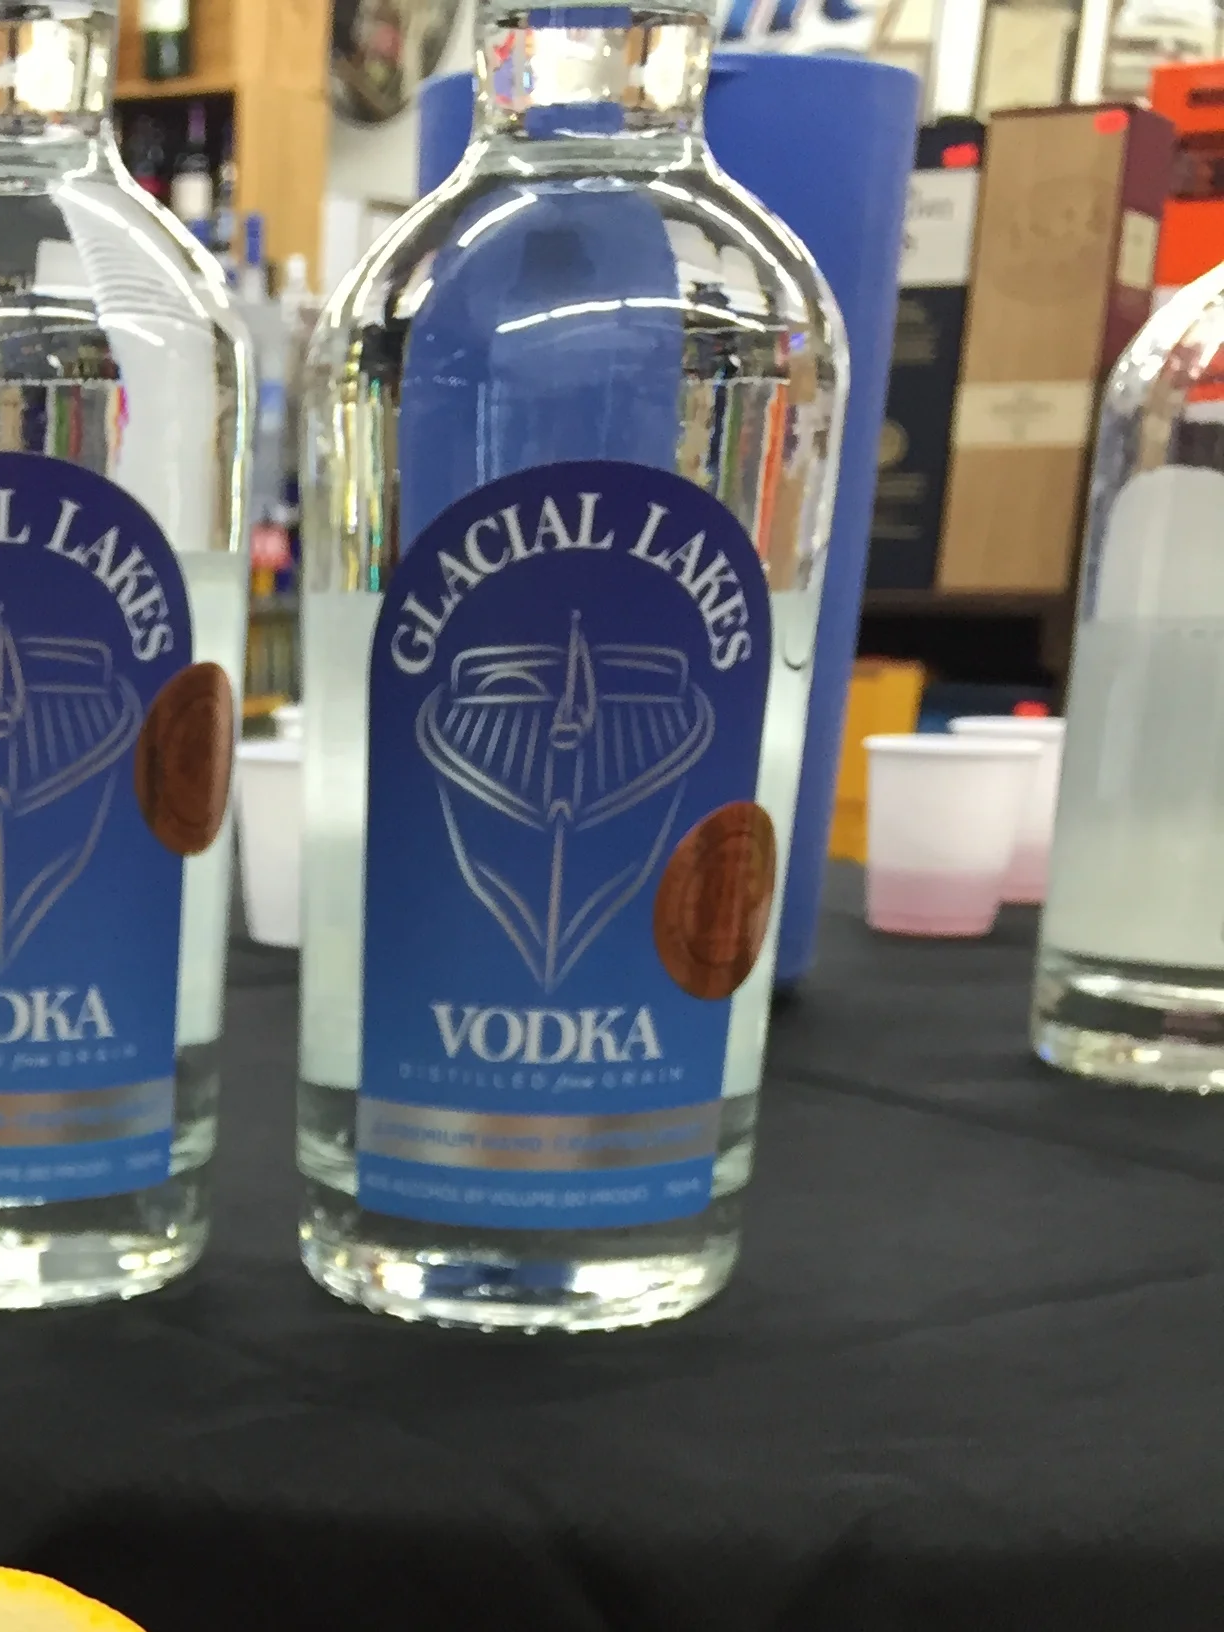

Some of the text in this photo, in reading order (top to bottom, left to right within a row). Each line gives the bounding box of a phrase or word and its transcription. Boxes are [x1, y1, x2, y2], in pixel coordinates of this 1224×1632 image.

[44, 497, 174, 662] LAKES
[390, 492, 753, 675] GLACIAL LAKES
[429, 1001, 665, 1064] VODKA
